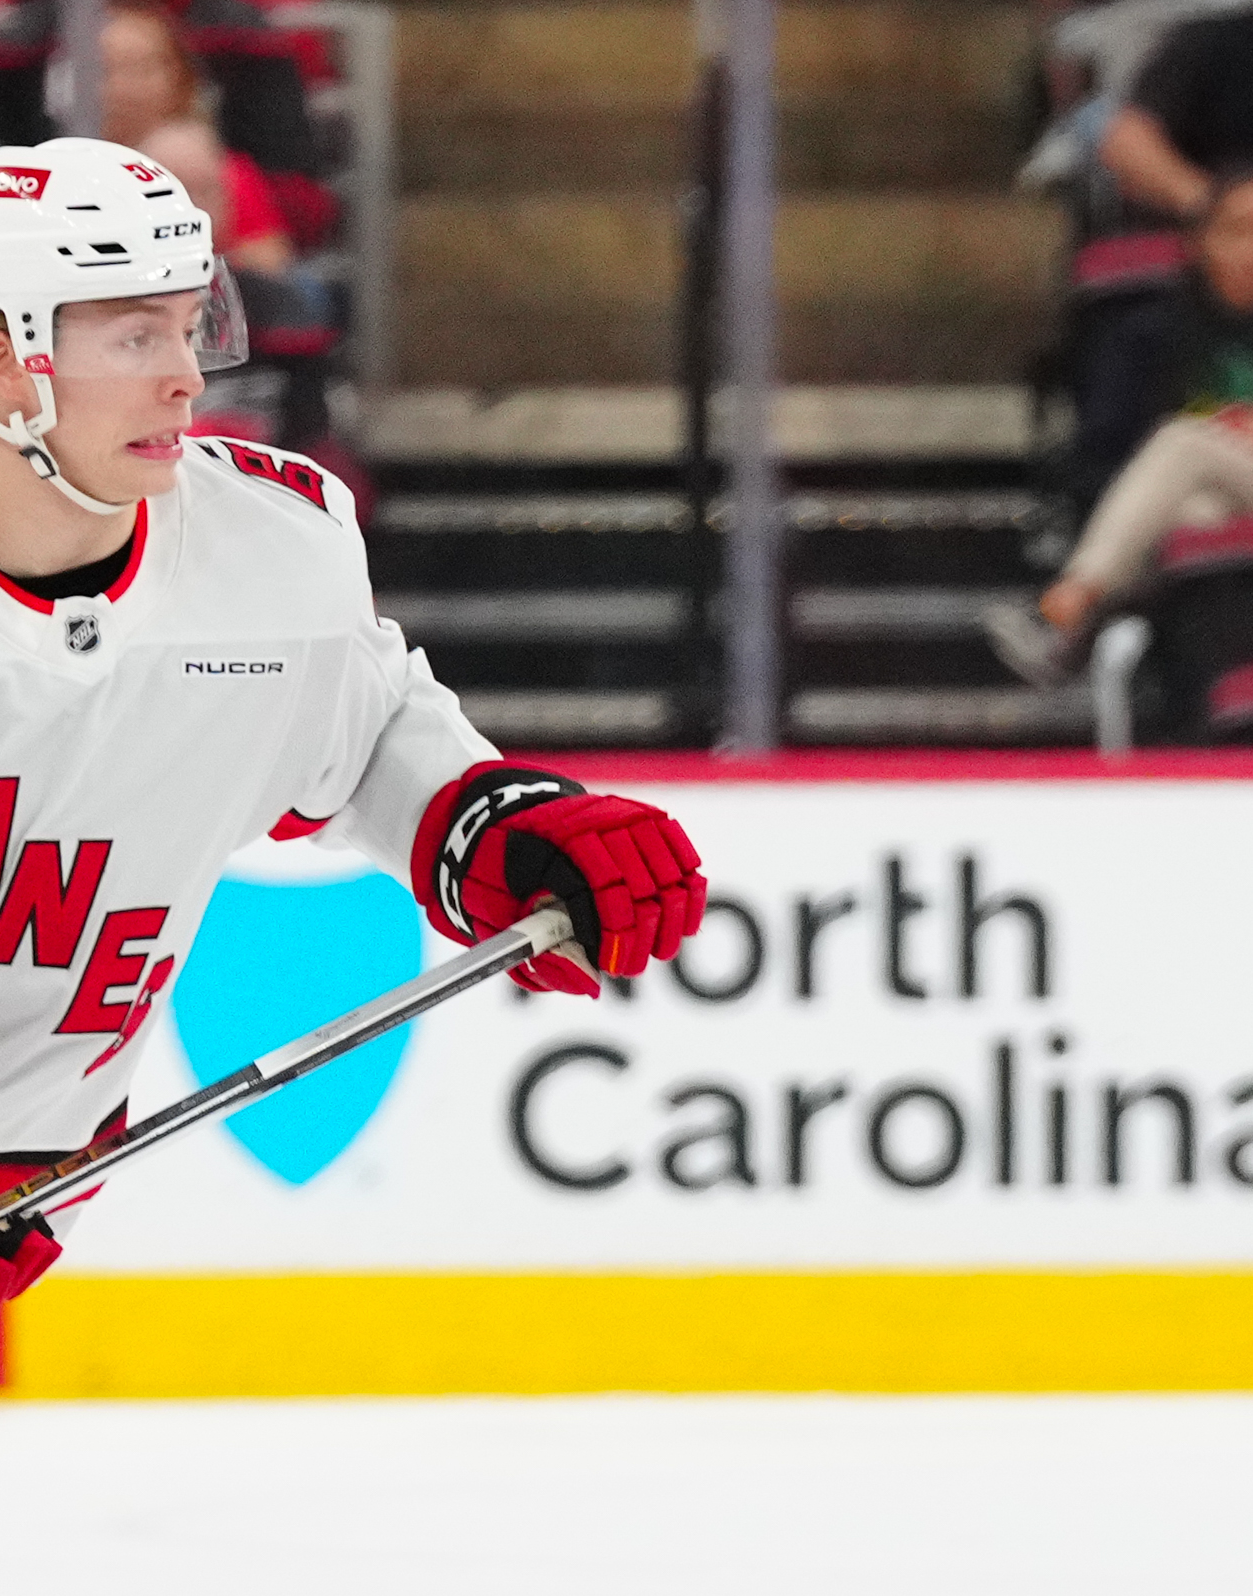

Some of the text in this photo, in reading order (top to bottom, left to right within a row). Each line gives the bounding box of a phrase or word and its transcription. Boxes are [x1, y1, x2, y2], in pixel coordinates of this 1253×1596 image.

[153, 220, 201, 239] CCM
[184, 661, 284, 674] NUCOR
[511, 855, 1053, 1006] orth
[509, 1034, 1253, 1191] Carolin
